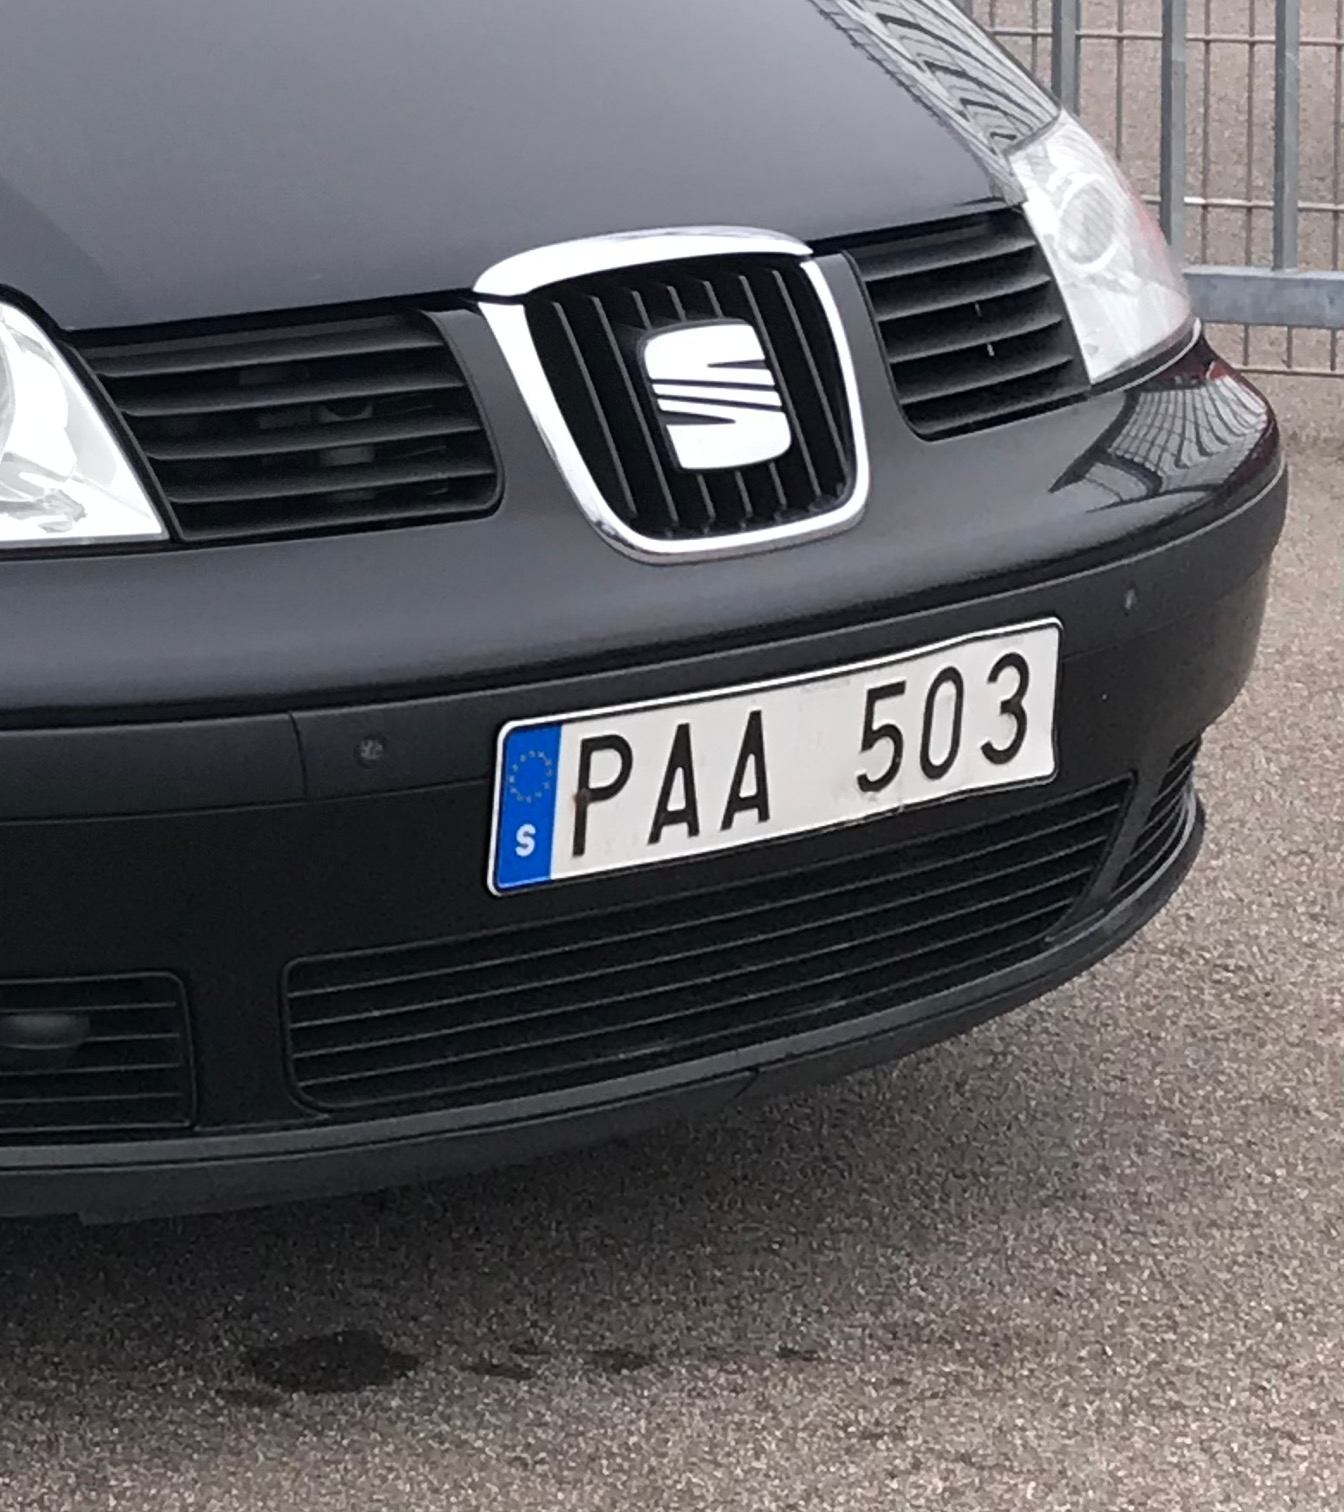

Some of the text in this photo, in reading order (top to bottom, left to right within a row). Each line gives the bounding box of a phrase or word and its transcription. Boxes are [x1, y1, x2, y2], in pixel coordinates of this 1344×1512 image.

[571, 651, 1031, 858] PAA 503
[515, 823, 537, 857] S
